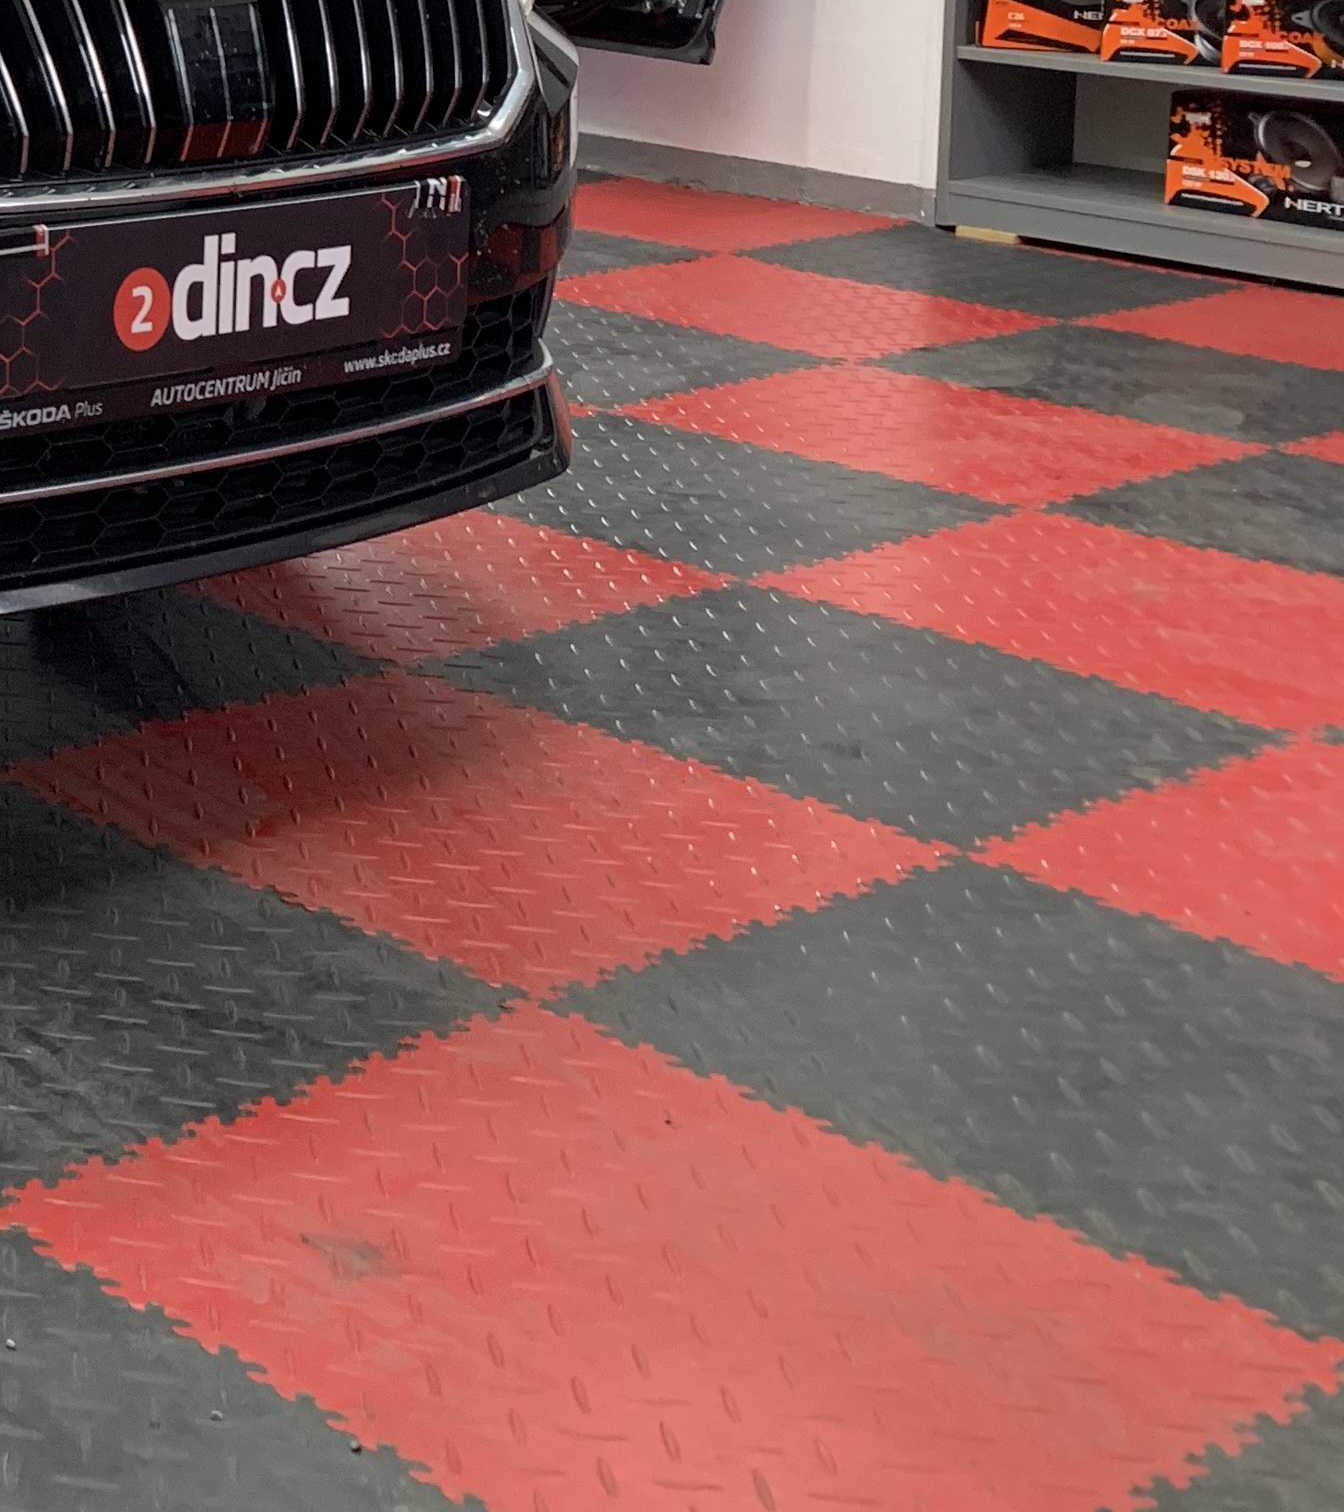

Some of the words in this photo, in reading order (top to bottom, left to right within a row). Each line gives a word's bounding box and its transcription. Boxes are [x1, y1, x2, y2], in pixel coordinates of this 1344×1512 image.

[1284, 196, 1344, 215] HERT
[150, 372, 270, 407] AUTOCENTRUM
[74, 400, 104, 418] Plus
